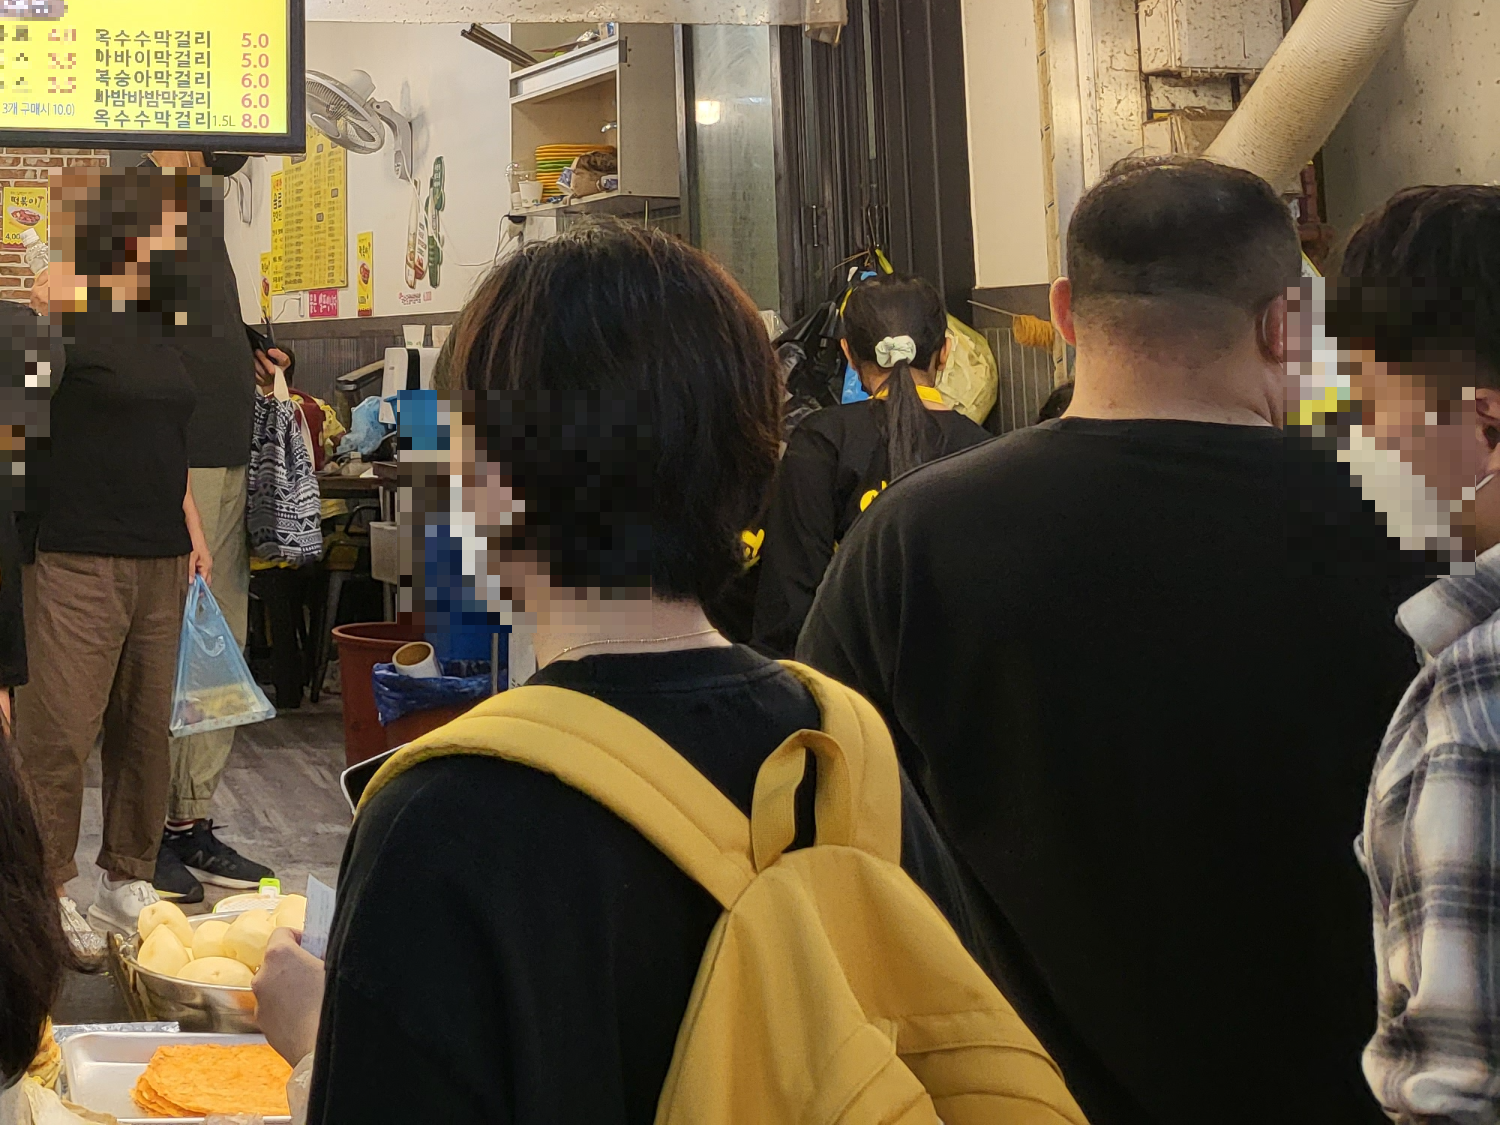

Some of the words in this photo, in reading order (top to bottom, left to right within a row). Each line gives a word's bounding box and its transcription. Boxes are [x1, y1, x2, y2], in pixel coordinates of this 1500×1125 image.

[242, 33, 269, 48] 5.0
[241, 53, 269, 68] 5.0
[241, 73, 269, 88] 6.0
[241, 93, 269, 108] 6.0
[2, 102, 17, 115] 3개
[21, 103, 49, 116] 구매시
[53, 104, 74, 116] 10.0)
[94, 109, 210, 127] 옥수수막걸리
[213, 115, 235, 126] 1.5L
[242, 114, 269, 128] 8.0
